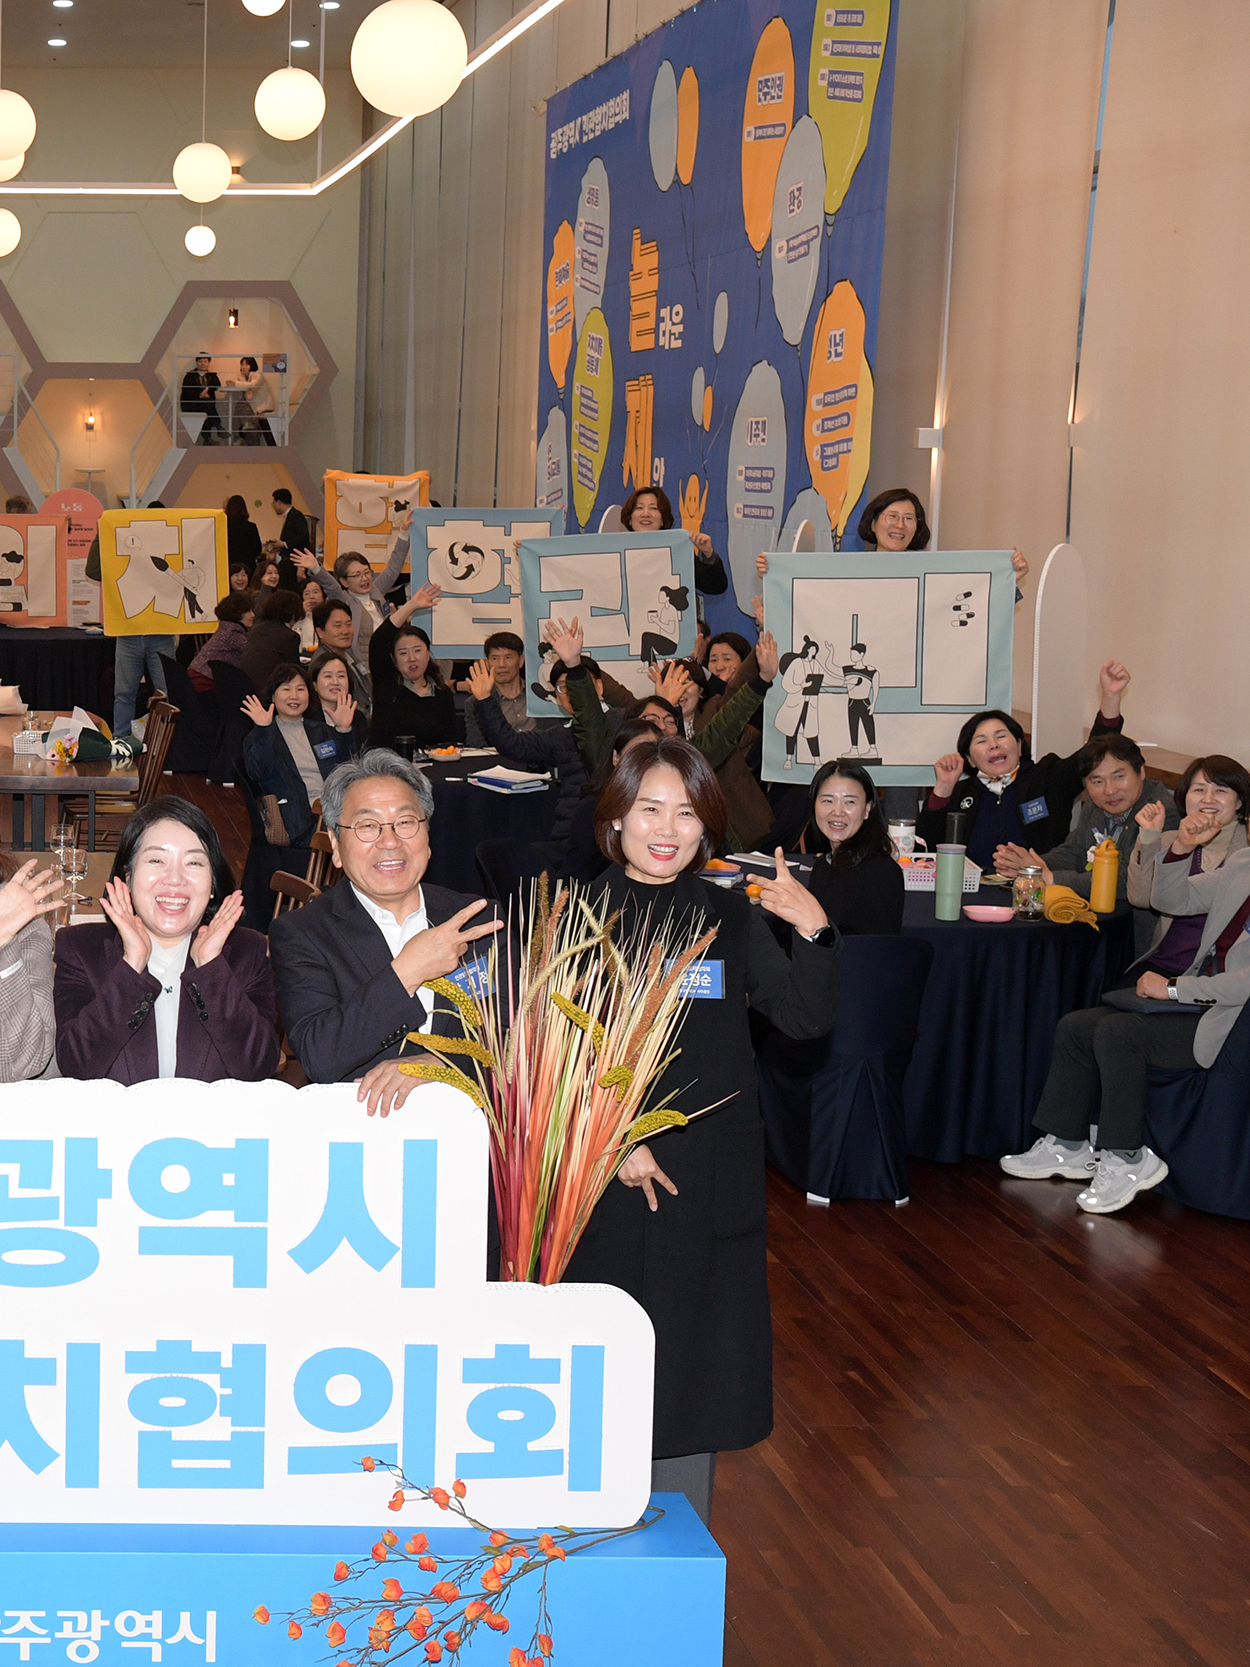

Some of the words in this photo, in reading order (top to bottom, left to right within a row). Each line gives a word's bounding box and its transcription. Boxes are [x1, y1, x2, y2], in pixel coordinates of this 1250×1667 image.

[758, 75, 784, 103] 민주인권
[550, 117, 581, 159] 광주광역시
[582, 89, 630, 144] 민관협치협의회
[788, 185, 803, 215] 환경
[747, 419, 768, 444] 이주민
